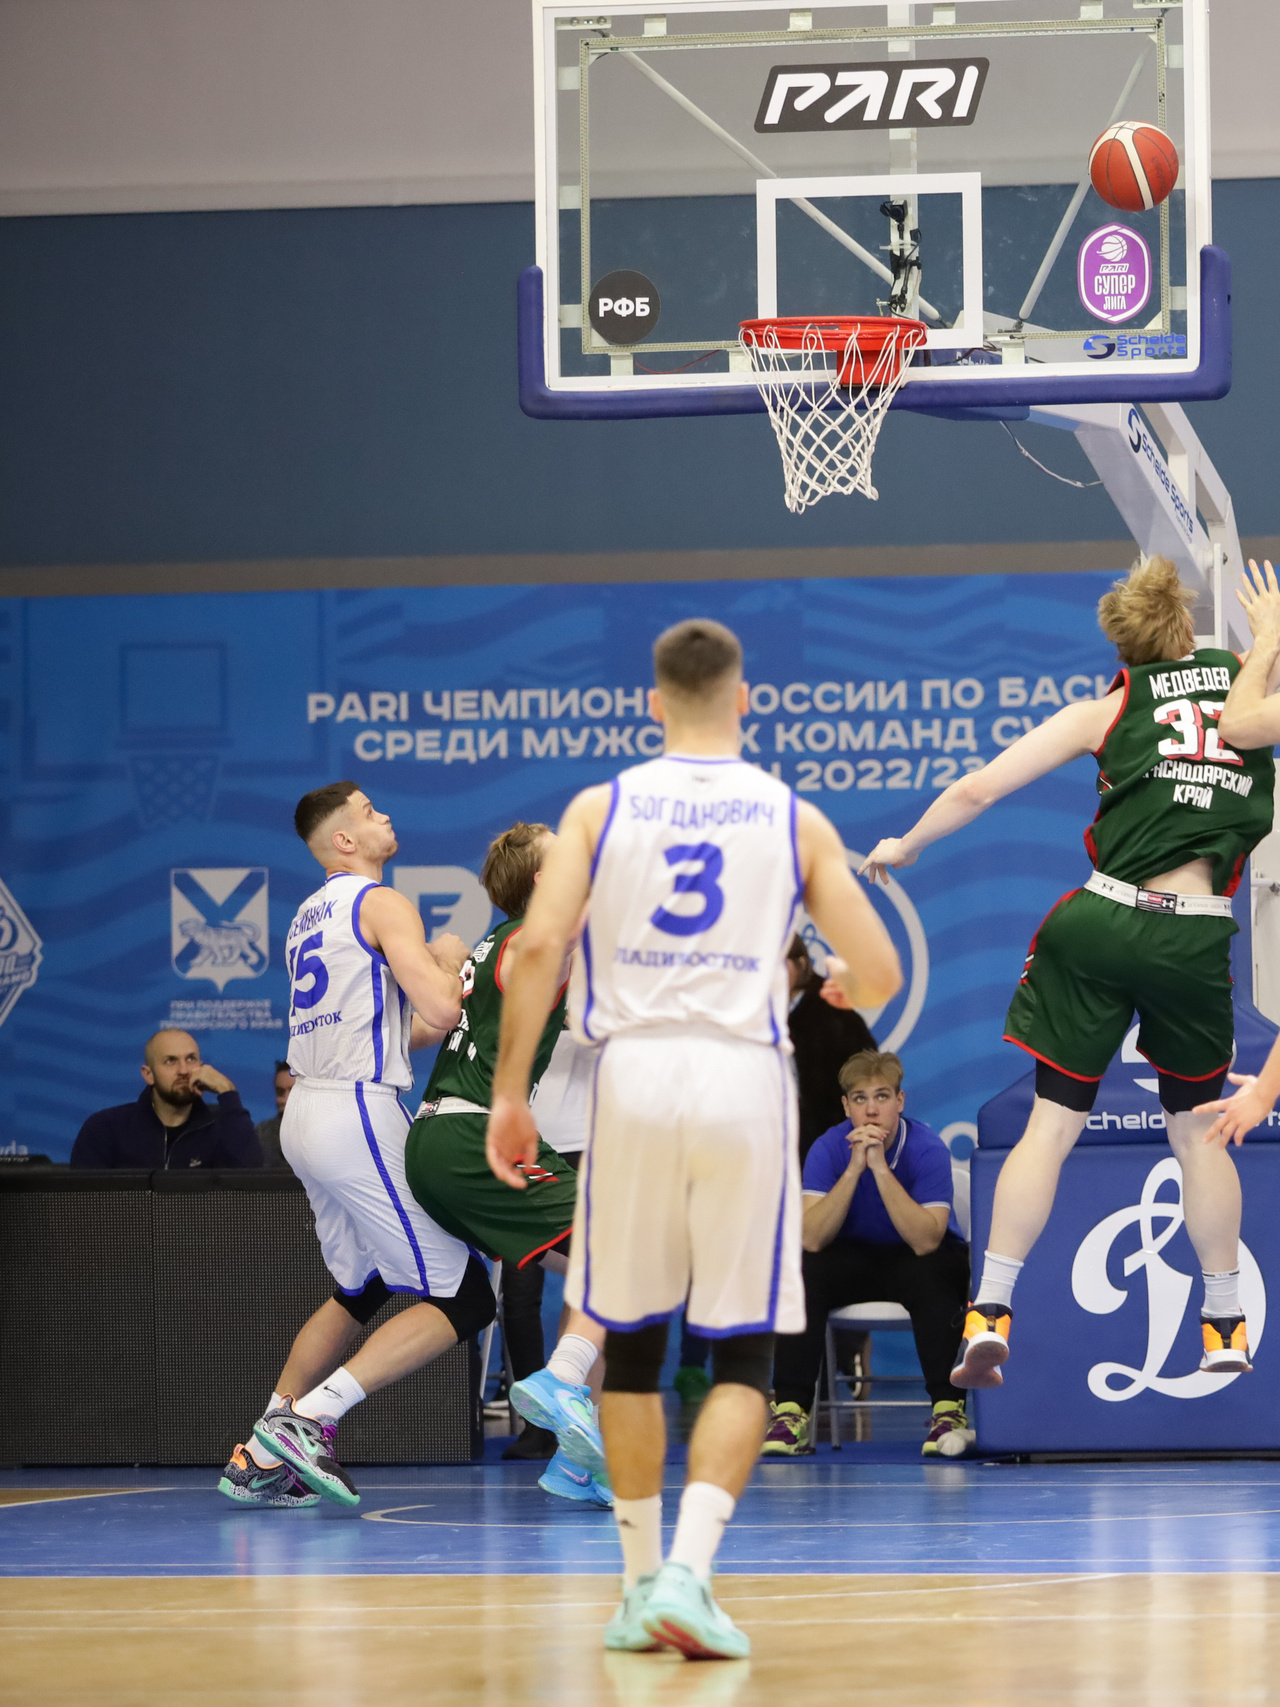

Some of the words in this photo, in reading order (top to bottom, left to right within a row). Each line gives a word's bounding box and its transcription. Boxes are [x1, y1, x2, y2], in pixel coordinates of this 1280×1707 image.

[764, 65, 979, 124] PARI
[598, 297, 650, 318] РФБ
[1103, 296, 1127, 311] ЛИГА
[1117, 333, 1187, 345] Schelde
[1117, 345, 1187, 359] Sports
[307, 691, 409, 723] PARI
[422, 687, 656, 721] ЧЕМПИОН
[748, 680, 908, 715] ОССИИ
[921, 678, 985, 710] ПО
[1148, 667, 1231, 700] МЕДВЕДЕВ
[353, 729, 509, 764] СРЕДИ
[774, 718, 978, 753] КОМАНД
[1153, 698, 1245, 767] 32
[629, 795, 775, 830] БОГДАНОВИЧ
[1172, 783, 1214, 810] КРАЙ
[649, 841, 725, 938] 3
[289, 930, 330, 1018] 15
